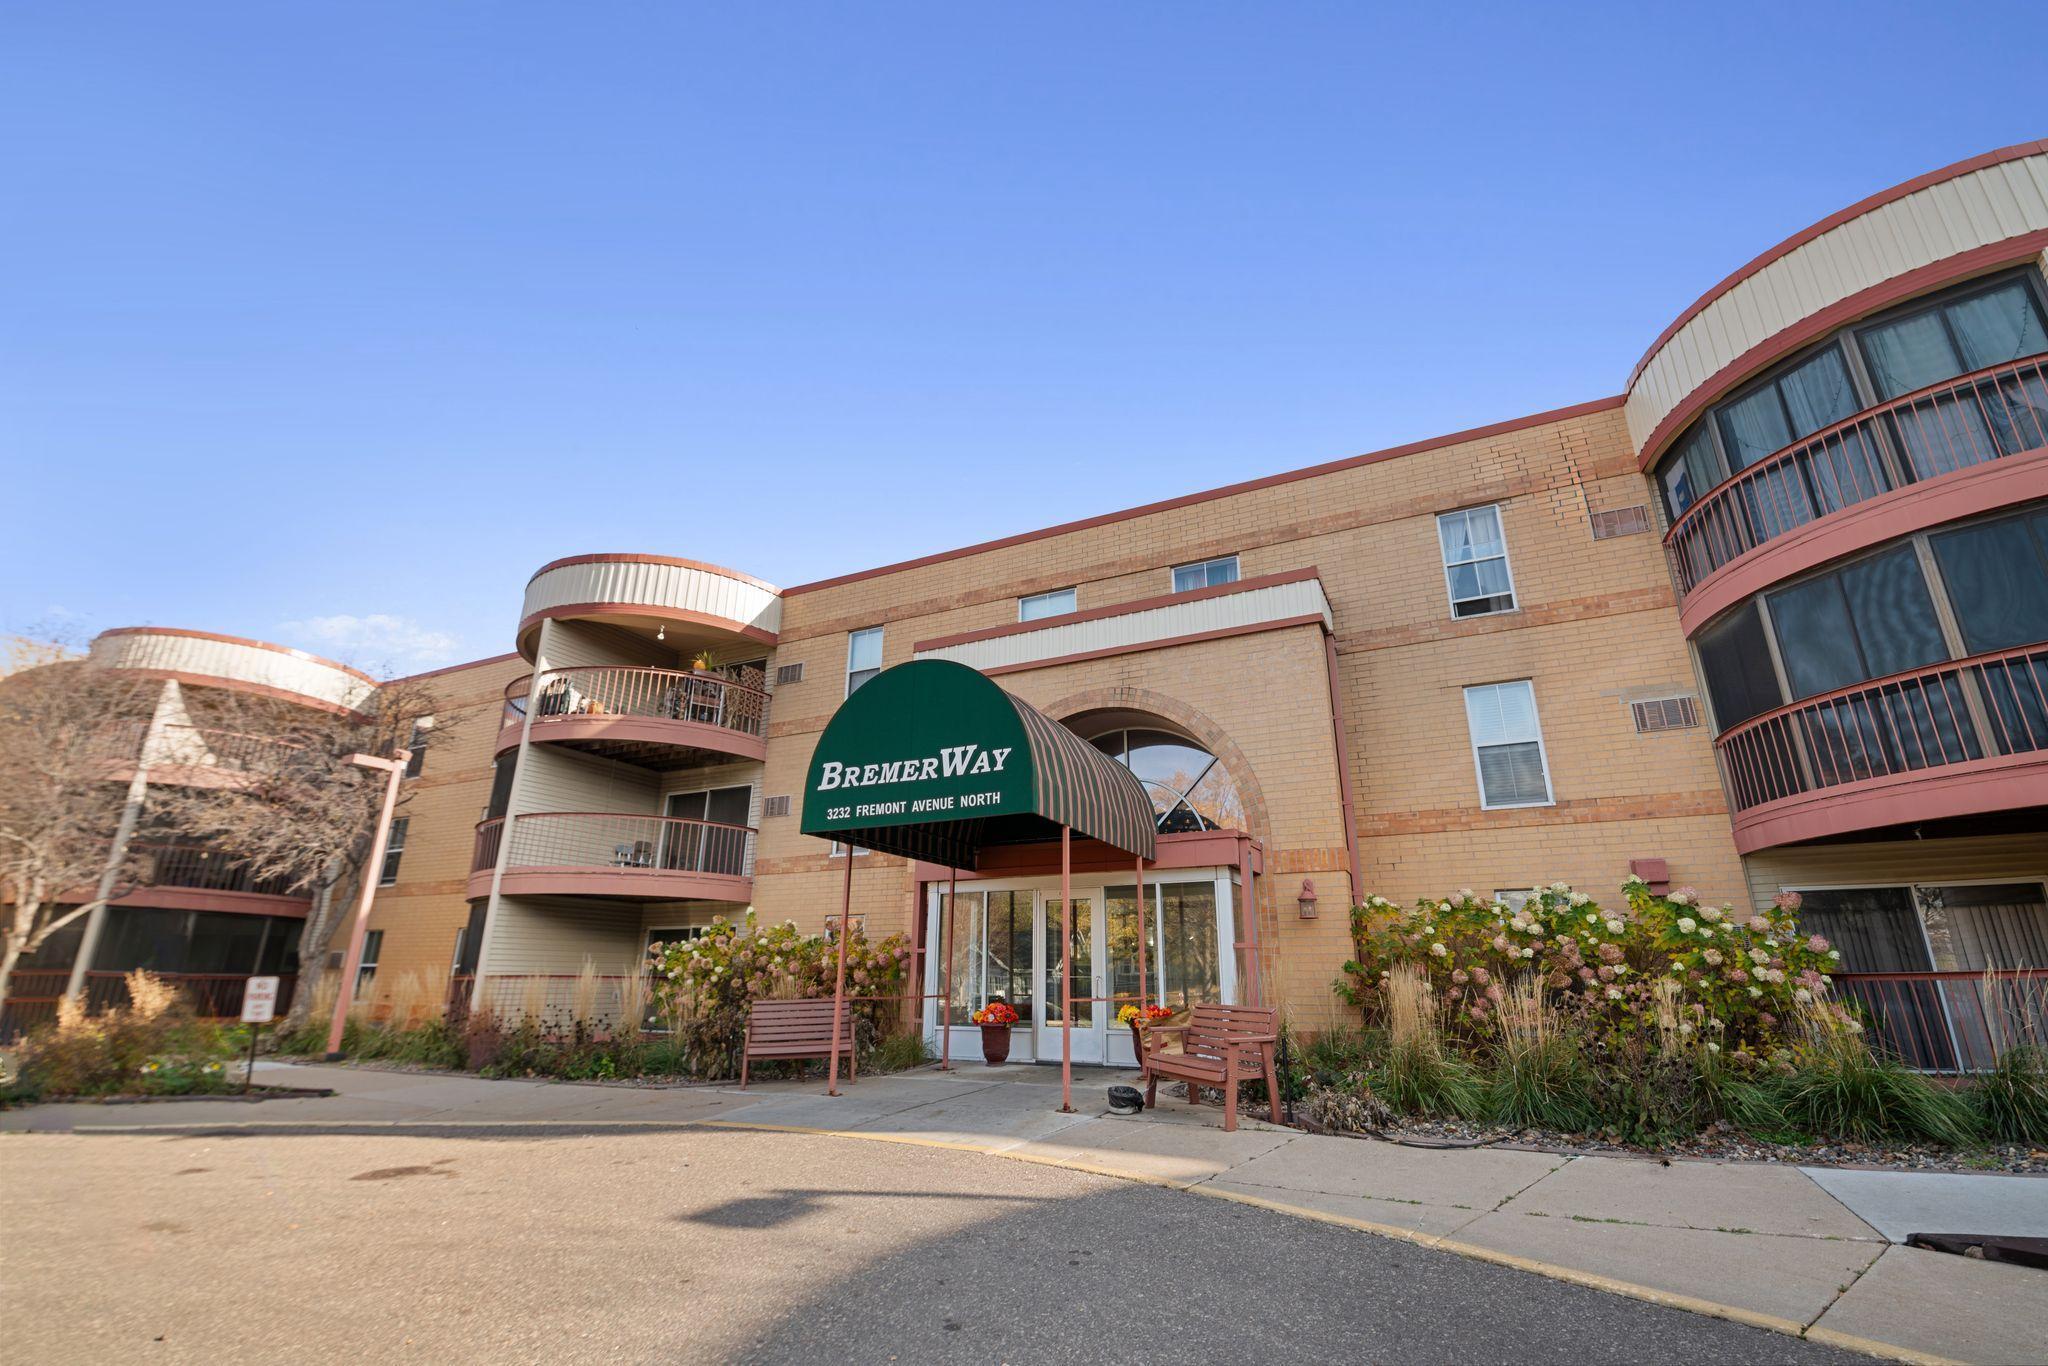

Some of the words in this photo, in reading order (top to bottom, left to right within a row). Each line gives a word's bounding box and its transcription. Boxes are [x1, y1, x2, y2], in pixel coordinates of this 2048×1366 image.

[827, 806, 851, 820] 3232
[856, 801, 907, 817] FREMONT
[911, 796, 954, 813] AVENUE
[960, 791, 1001, 808] NORTH
